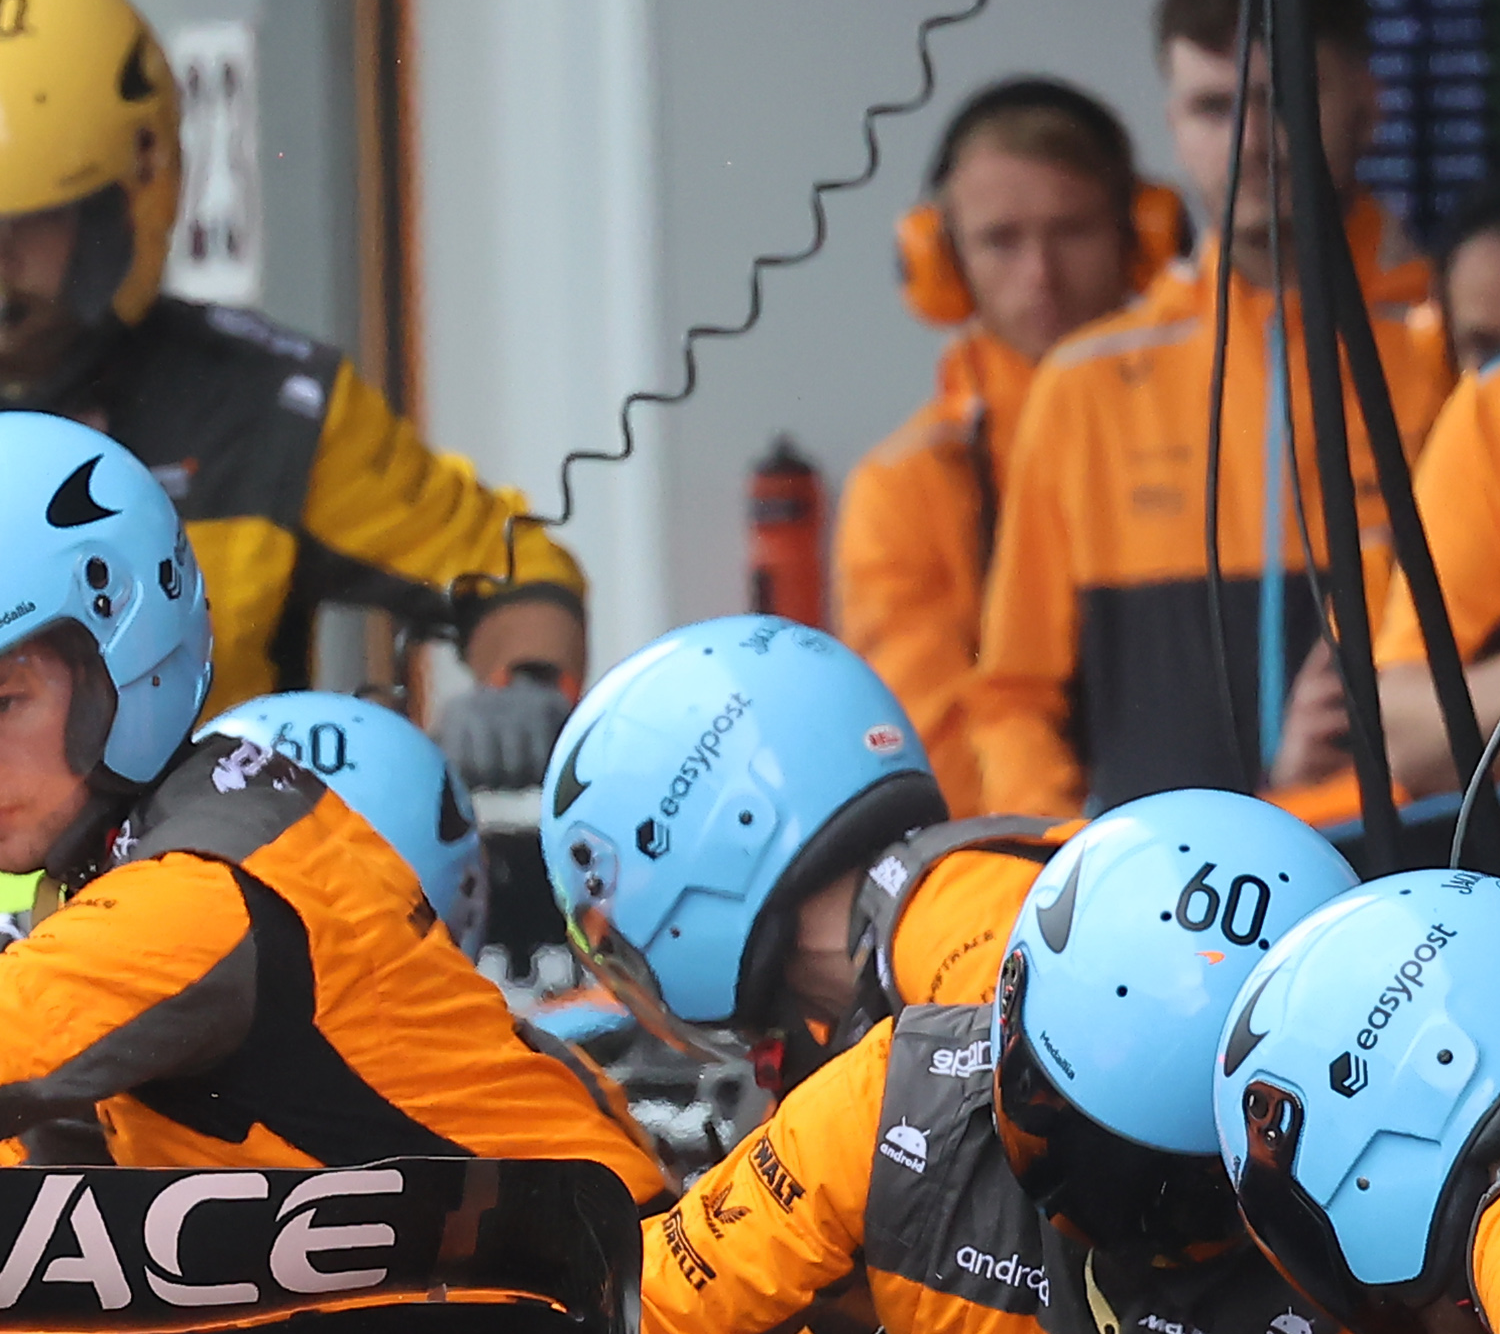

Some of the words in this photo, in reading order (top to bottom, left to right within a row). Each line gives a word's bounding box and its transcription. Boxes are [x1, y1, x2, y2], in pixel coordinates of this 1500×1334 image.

[662, 692, 753, 820] easypost
[1175, 861, 1271, 947] 60
[1356, 922, 1458, 1052] easypost
[1039, 1030, 1076, 1082] Medallia
[752, 1135, 807, 1210] WALT
[879, 1141, 927, 1175] android
